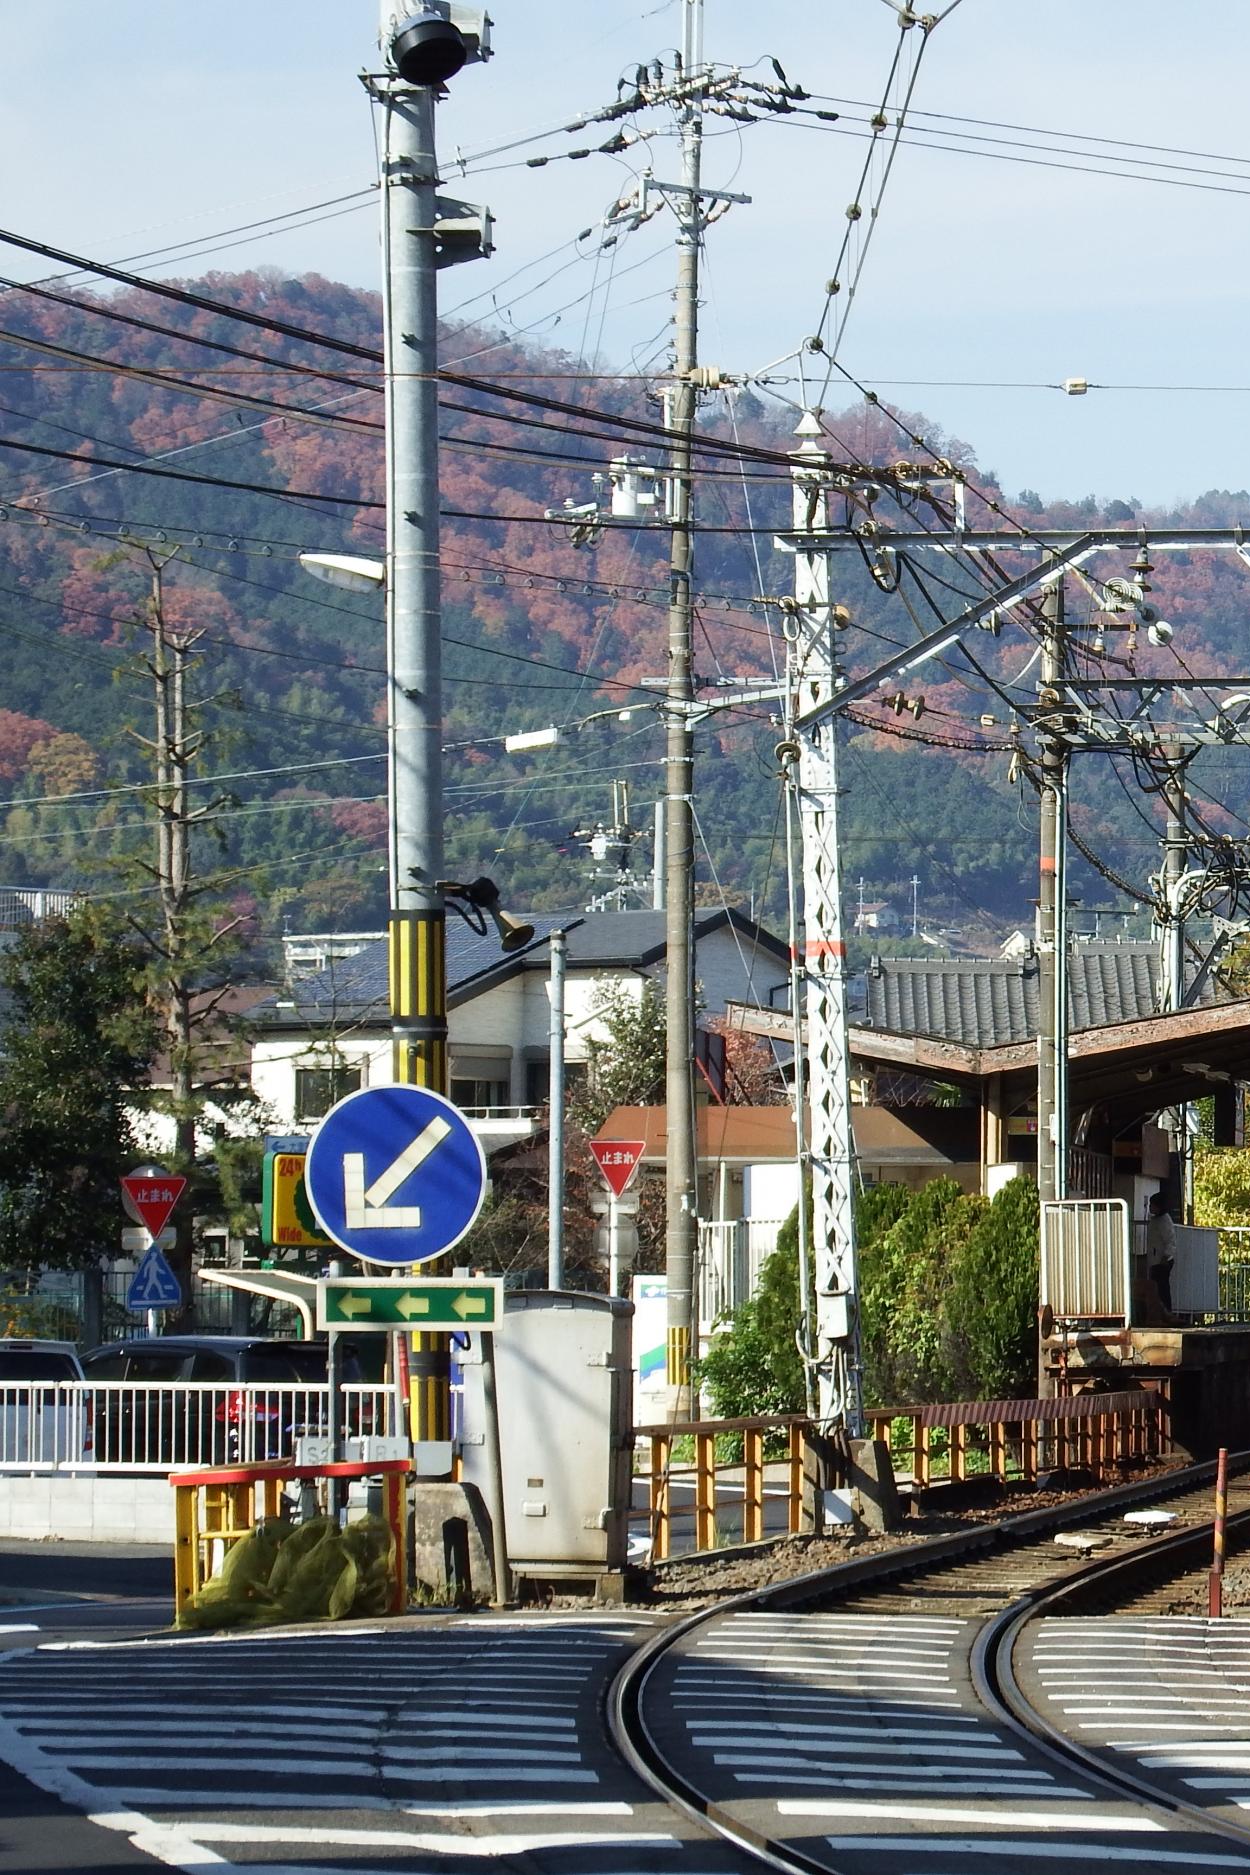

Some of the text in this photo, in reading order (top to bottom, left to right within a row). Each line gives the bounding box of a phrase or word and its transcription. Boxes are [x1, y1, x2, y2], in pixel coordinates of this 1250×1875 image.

[601, 1151, 635, 1165] 止まれ
[279, 1158, 302, 1177] 24h
[136, 1188, 174, 1203] 止まれ
[278, 1227, 303, 1242] Wide
